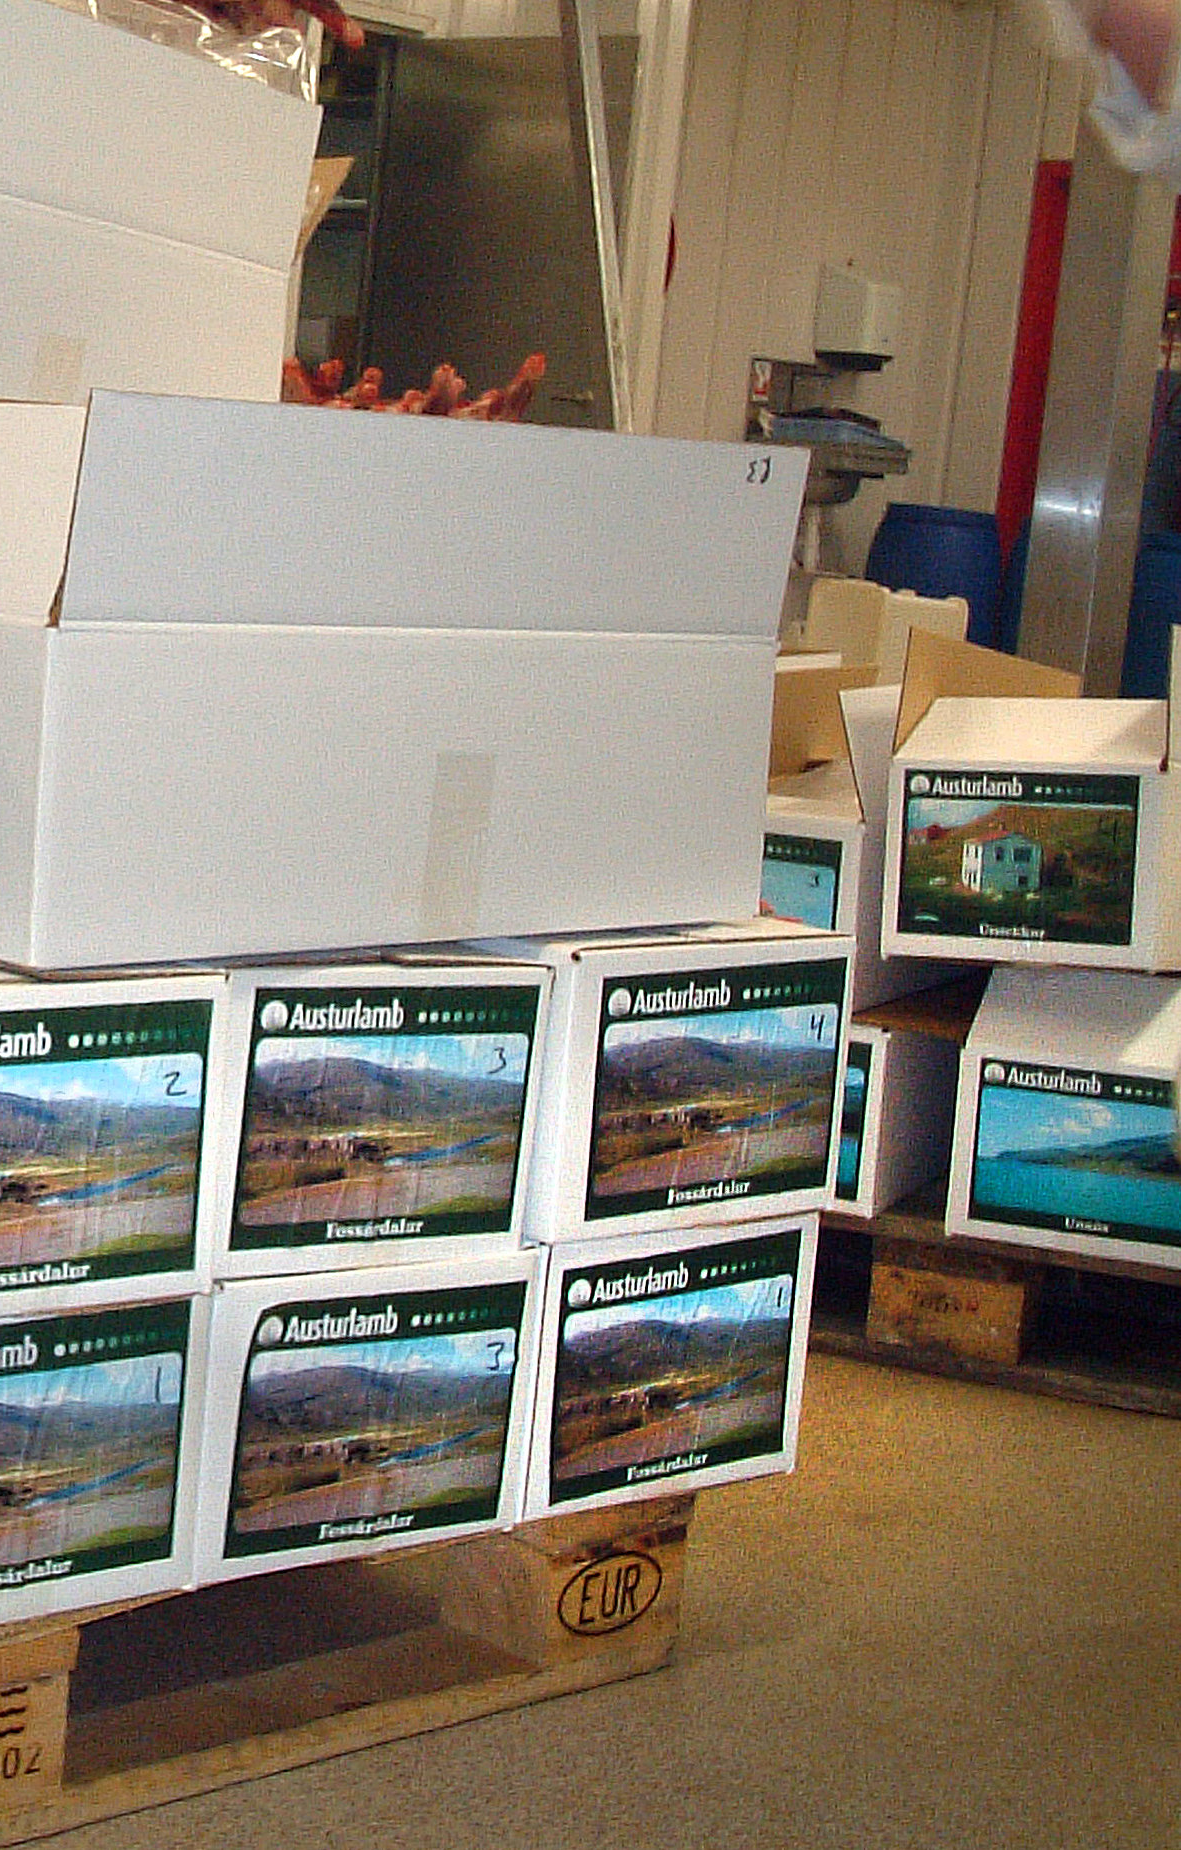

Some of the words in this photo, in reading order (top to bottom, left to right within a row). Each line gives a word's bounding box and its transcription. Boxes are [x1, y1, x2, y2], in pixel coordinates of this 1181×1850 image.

[932, 776, 1022, 797] Austurlamb
[633, 979, 730, 1014] Austurlamb
[290, 998, 404, 1030] Austurlamb
[163, 1072, 187, 1096] 2
[1007, 1068, 1101, 1094] Austurlamb
[593, 1262, 688, 1303] Austurlamb
[284, 1305, 398, 1342] Austurlamb
[579, 1563, 641, 1624] EUR
